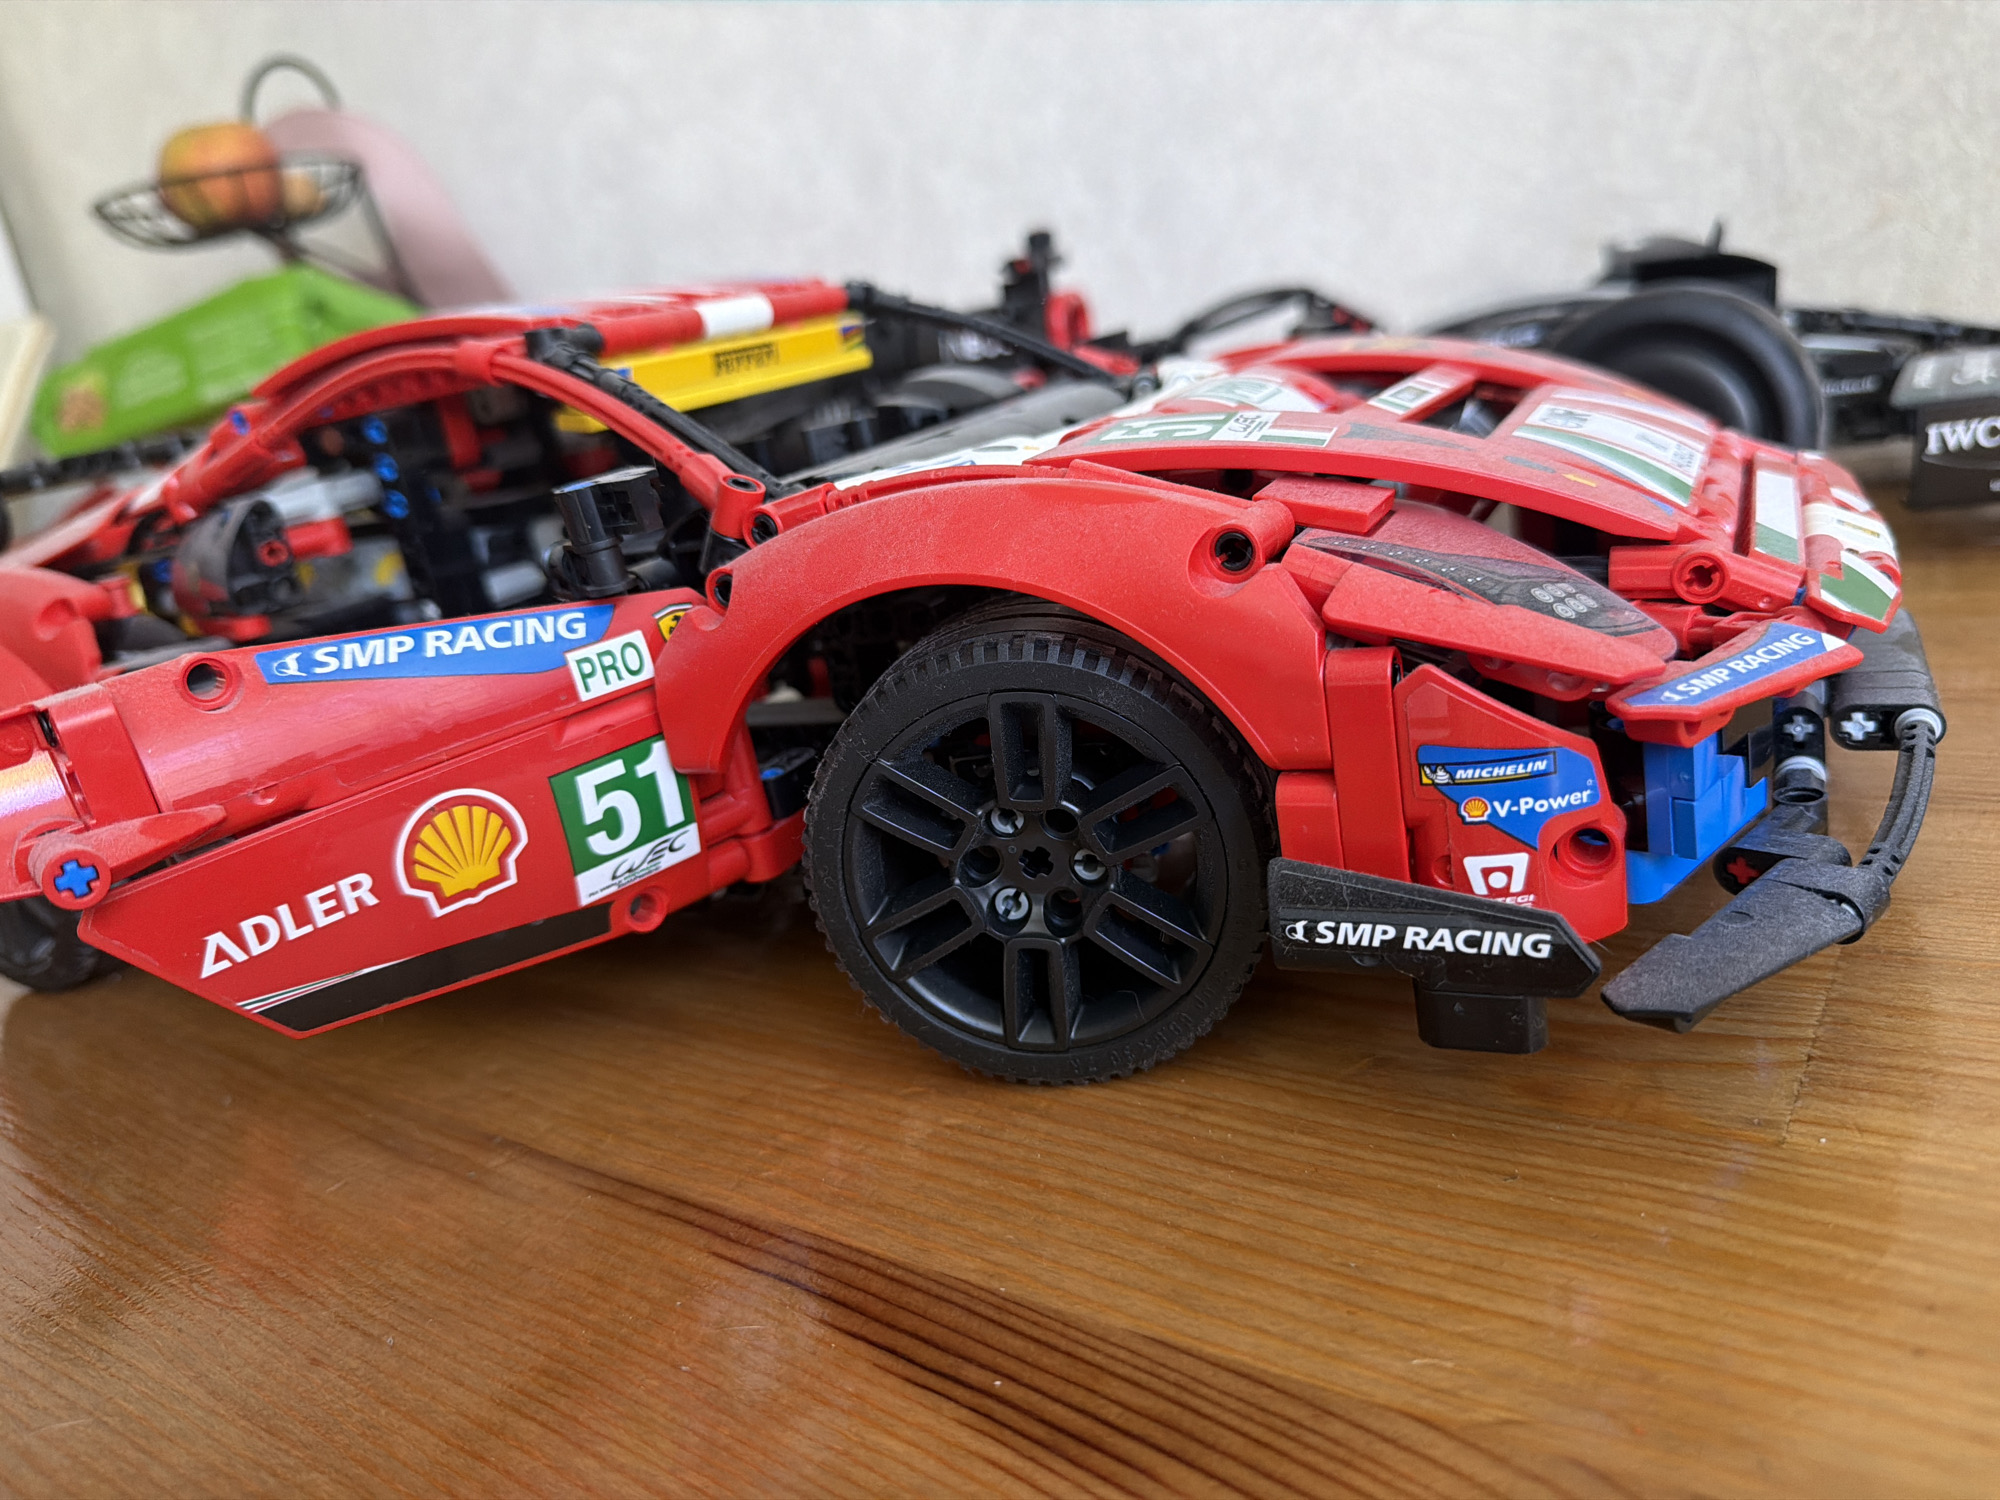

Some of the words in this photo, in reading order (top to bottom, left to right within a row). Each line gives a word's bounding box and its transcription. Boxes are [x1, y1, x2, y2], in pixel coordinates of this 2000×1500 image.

[1925, 415, 2000, 455] IWC
[313, 634, 415, 674] SMP
[424, 612, 588, 658] RACING
[574, 641, 644, 694] PRO
[1676, 667, 1731, 696] SMP
[1727, 632, 1816, 675] RACING
[1455, 758, 1548, 780] MICHELIN
[574, 740, 686, 856] 51
[1493, 788, 1591, 818] V-Power
[610, 829, 690, 881] WEC
[199, 872, 381, 979] ADLER
[1315, 920, 1397, 948] SMP
[1403, 926, 1552, 959] RACING
